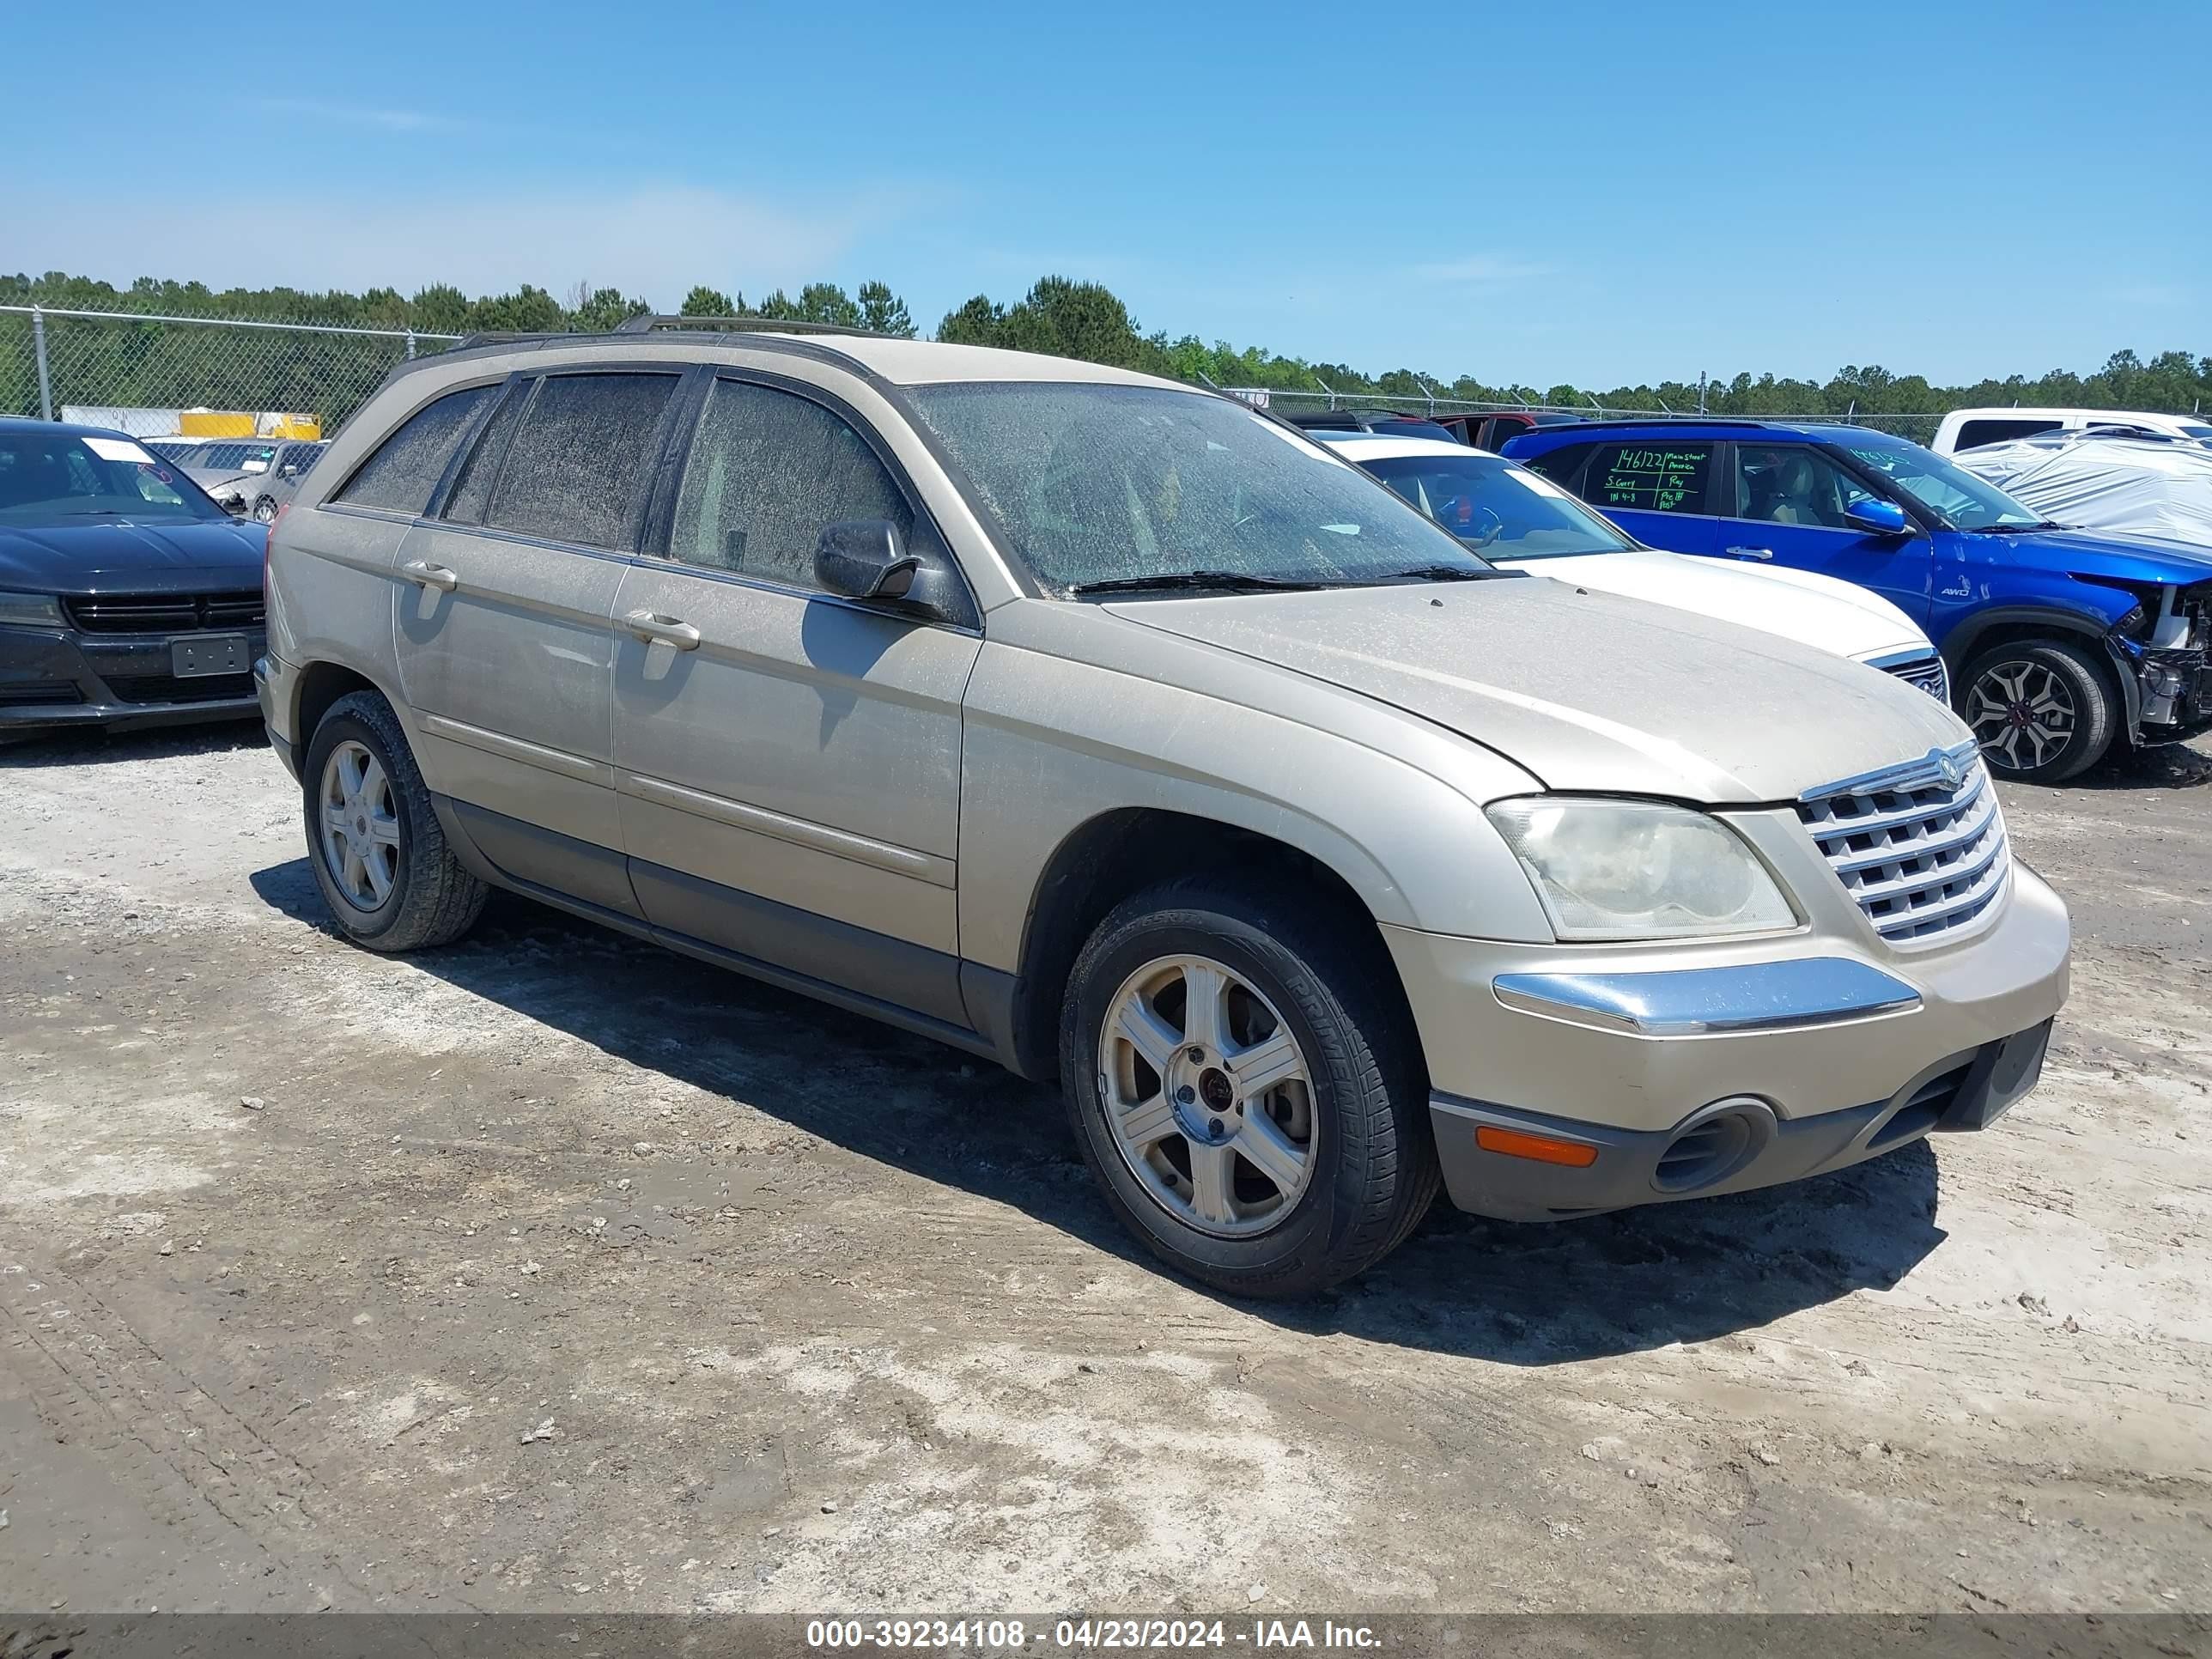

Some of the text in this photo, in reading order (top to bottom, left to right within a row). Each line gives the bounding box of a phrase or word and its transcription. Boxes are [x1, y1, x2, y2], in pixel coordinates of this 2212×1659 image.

[1617, 449, 1663, 469] 146122
[1942, 588, 1969, 597] AWD
[1286, 975, 1359, 1171] PRIMEWELL
